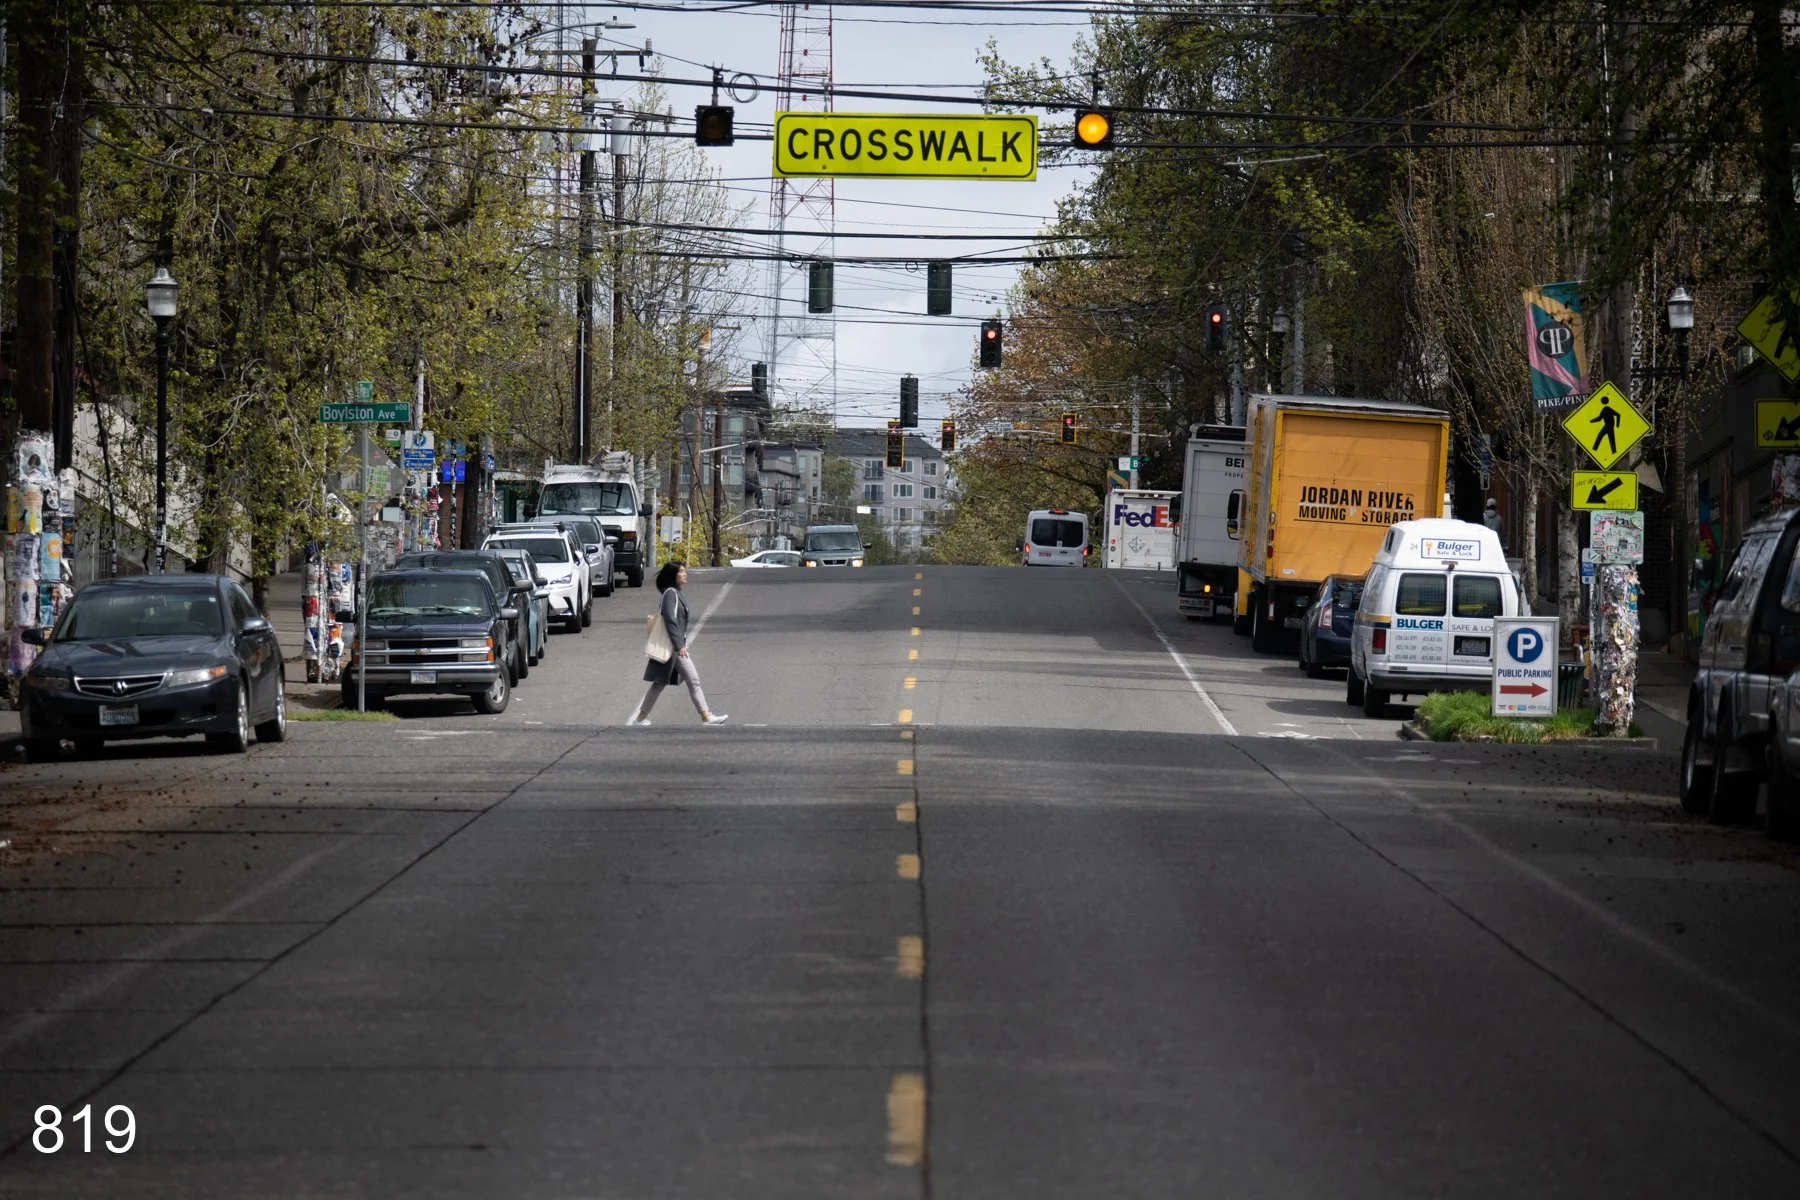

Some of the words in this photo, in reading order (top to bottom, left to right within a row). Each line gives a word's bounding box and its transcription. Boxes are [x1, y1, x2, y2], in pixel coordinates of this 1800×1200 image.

[788, 127, 1023, 163] CROSSWALK
[322, 405, 374, 422] Boylston
[378, 410, 396, 420] Ave
[395, 403, 408, 411] 600
[1300, 486, 1363, 507] JORDAN
[1367, 490, 1415, 511] RIVER
[1298, 505, 1347, 521] MOVING
[1436, 541, 1474, 552] Bulger
[1396, 618, 1444, 630] BULGER
[1451, 624, 1470, 632] SAFE
[1517, 633, 1537, 659] P
[1497, 669, 1522, 678] PUBLIC
[1523, 669, 1552, 678] PARKING
